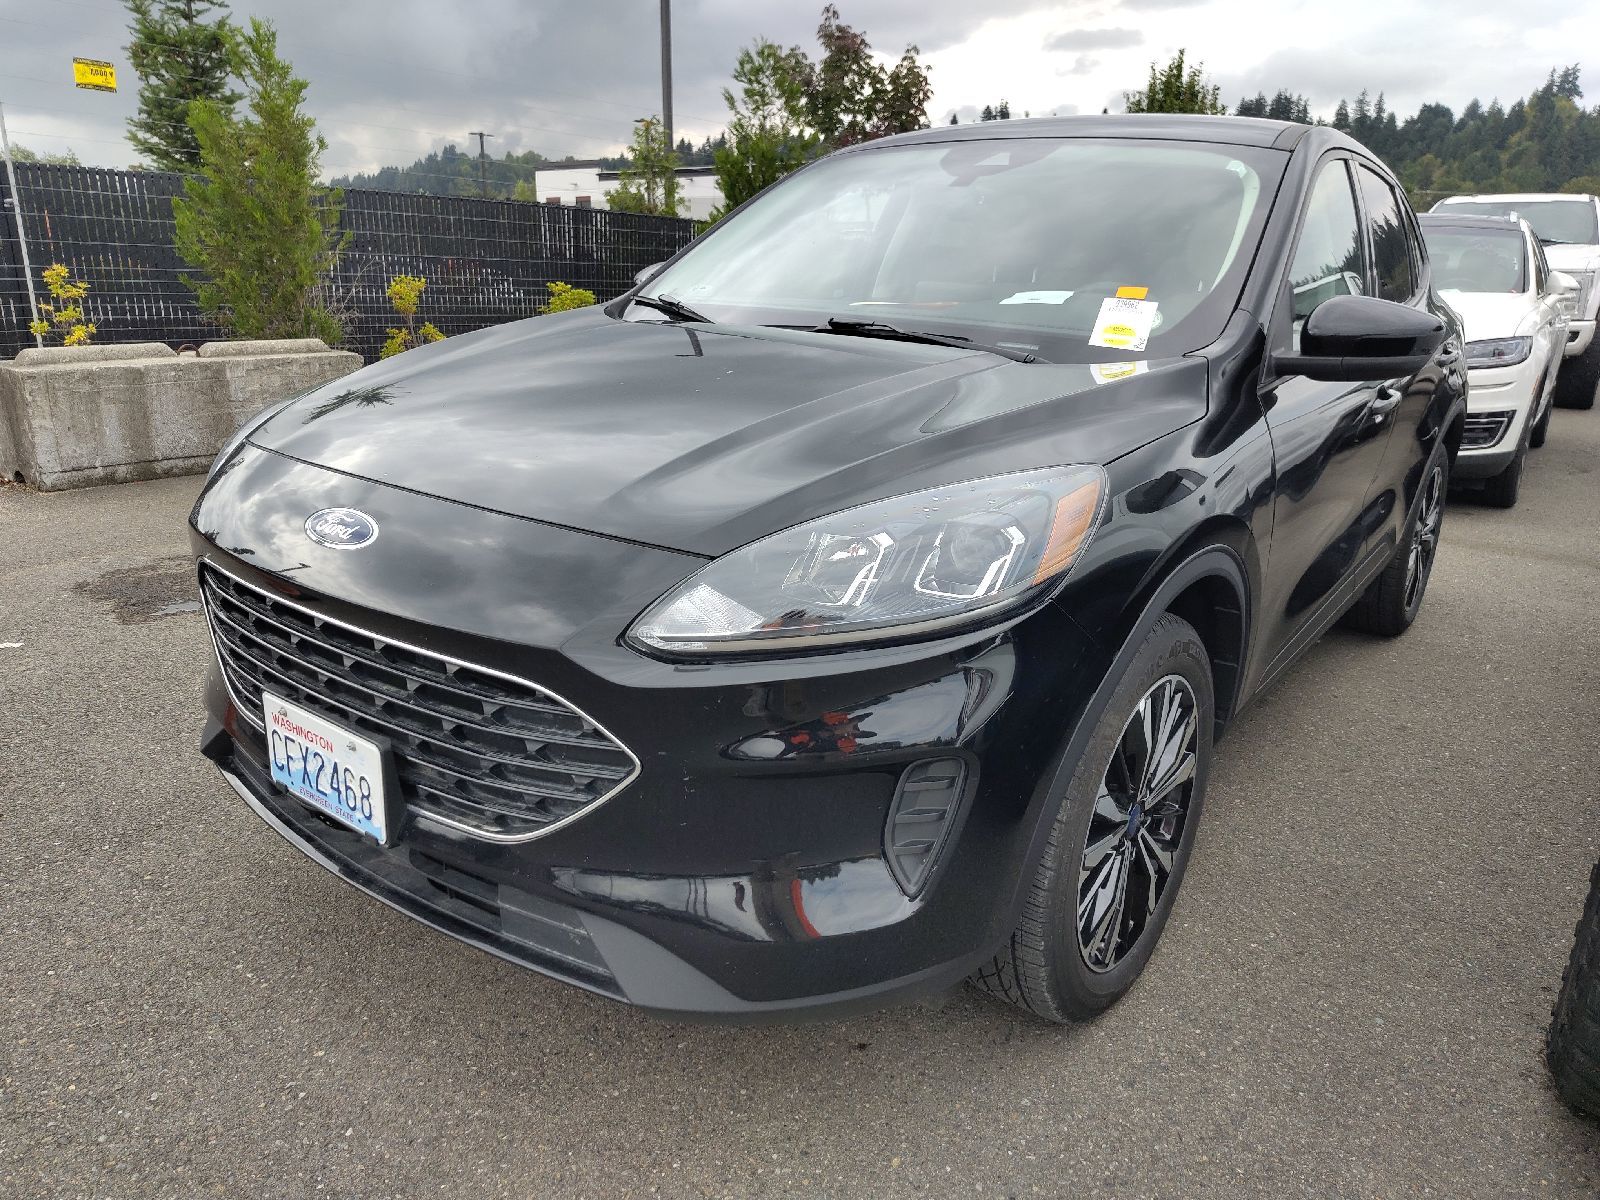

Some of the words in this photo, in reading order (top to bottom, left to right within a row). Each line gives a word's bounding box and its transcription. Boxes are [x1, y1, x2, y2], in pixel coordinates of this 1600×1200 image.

[315, 512, 361, 540] Ford
[271, 712, 334, 753] WASHINGTON
[272, 728, 373, 821] CFX2468
[299, 786, 333, 811] EVERGREEN
[335, 806, 355, 823] STATE
